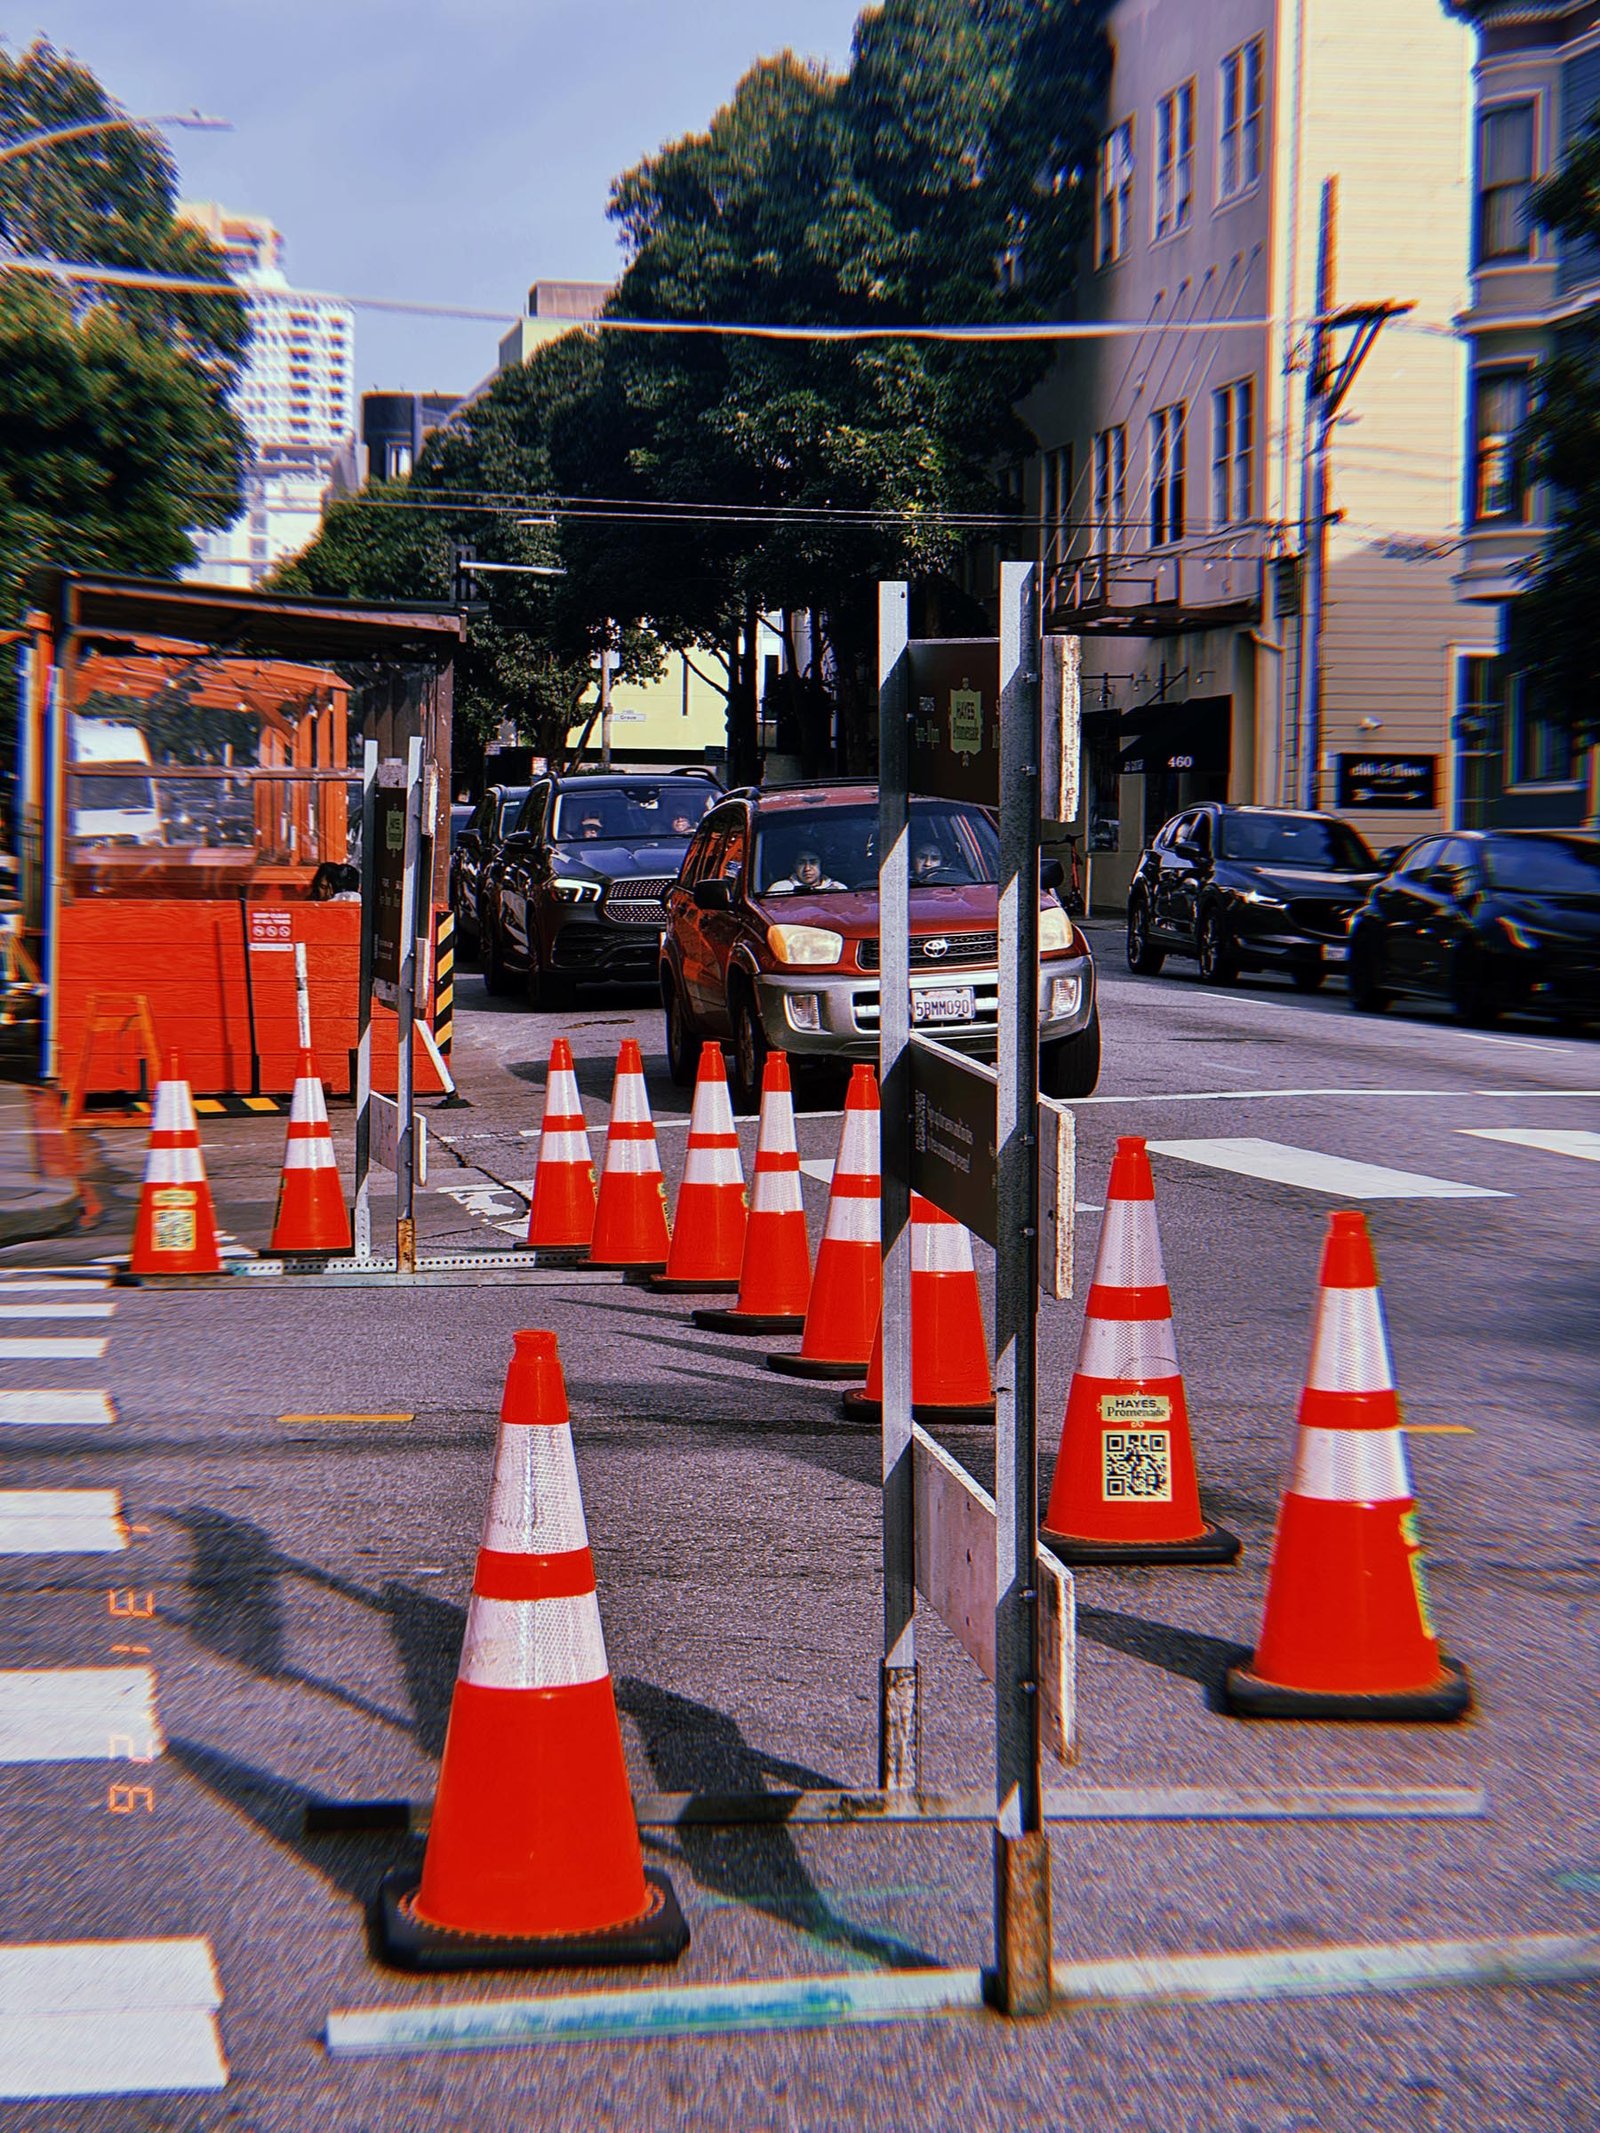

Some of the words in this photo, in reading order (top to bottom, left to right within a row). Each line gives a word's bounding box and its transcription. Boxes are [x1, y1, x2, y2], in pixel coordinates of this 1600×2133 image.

[1167, 755, 1193, 768] 460
[916, 1000, 969, 1017] 5BMM090
[1115, 1399, 1157, 1408] HAYES
[1107, 1406, 1166, 1417] Promenade
